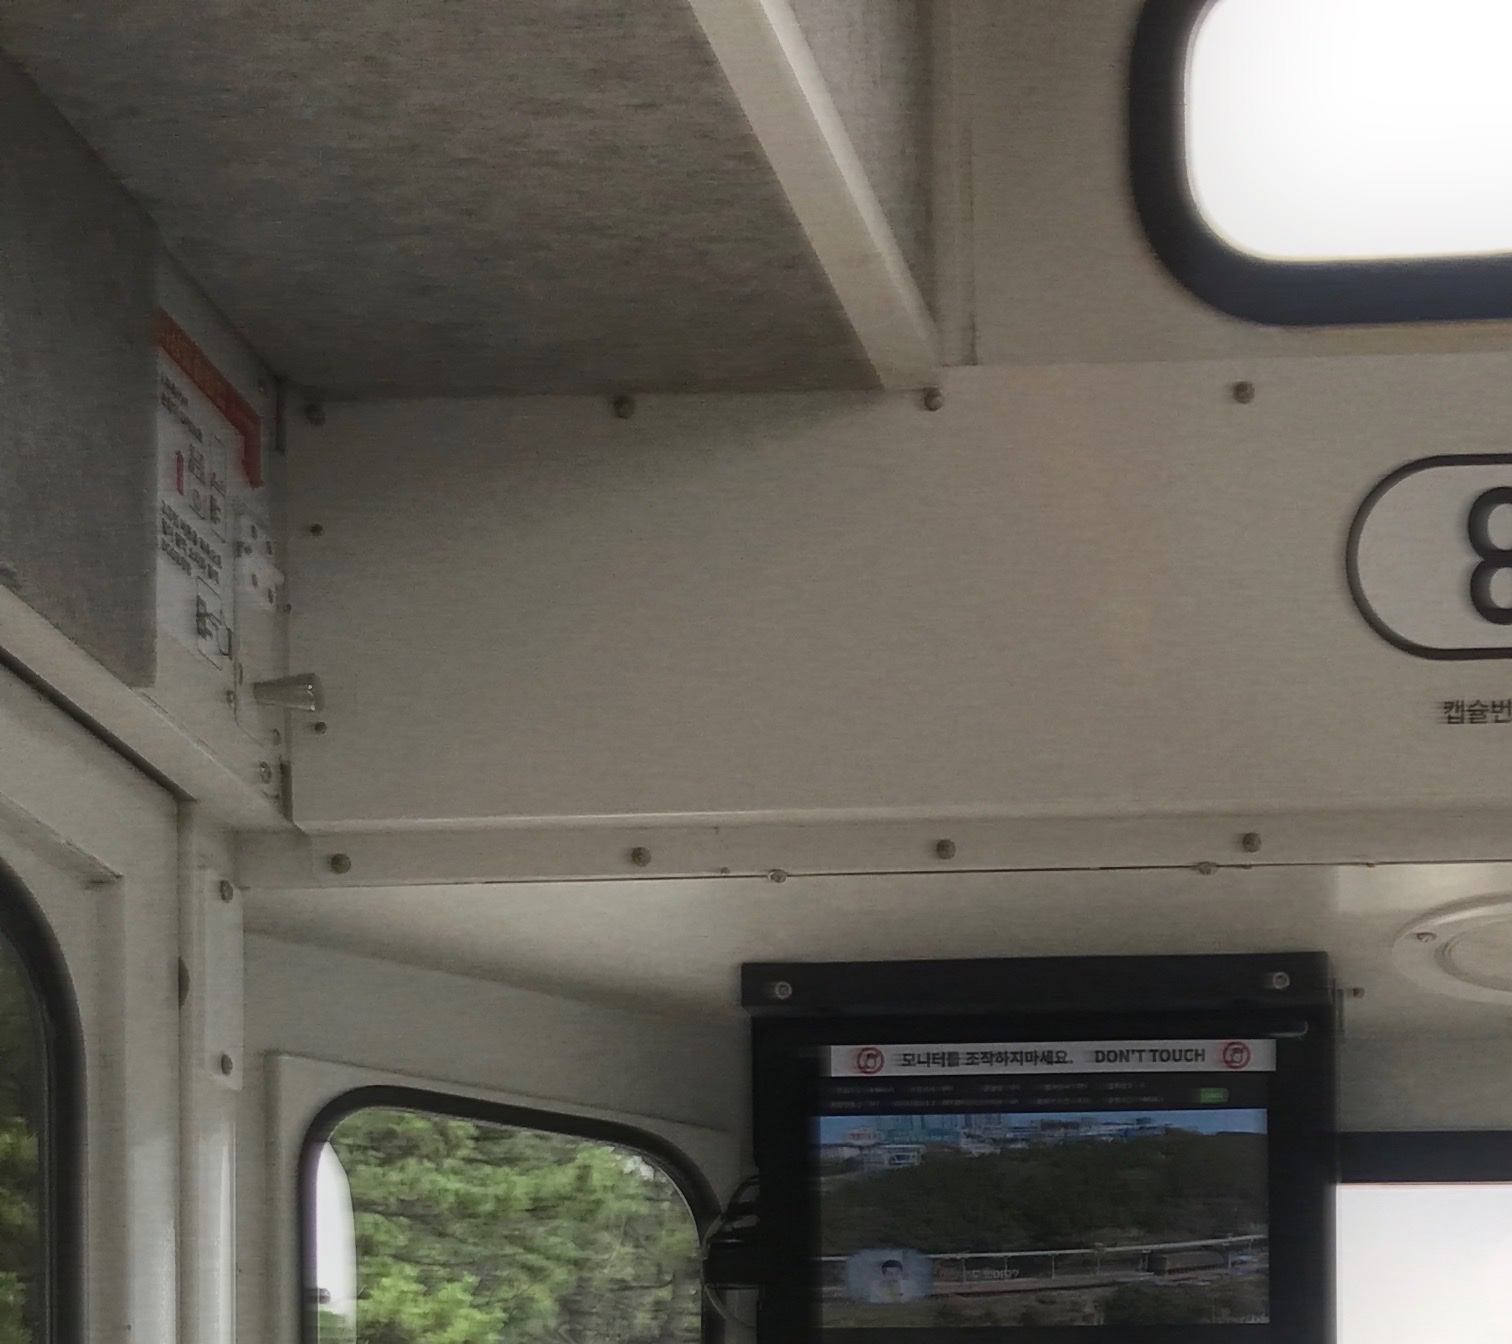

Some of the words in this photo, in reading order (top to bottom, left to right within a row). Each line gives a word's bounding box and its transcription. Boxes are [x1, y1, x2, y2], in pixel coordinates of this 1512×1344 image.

[901, 1051, 961, 1068] 모니터를
[1095, 1048, 1147, 1064] DON'T
[1150, 1047, 1206, 1063] TOUCH
